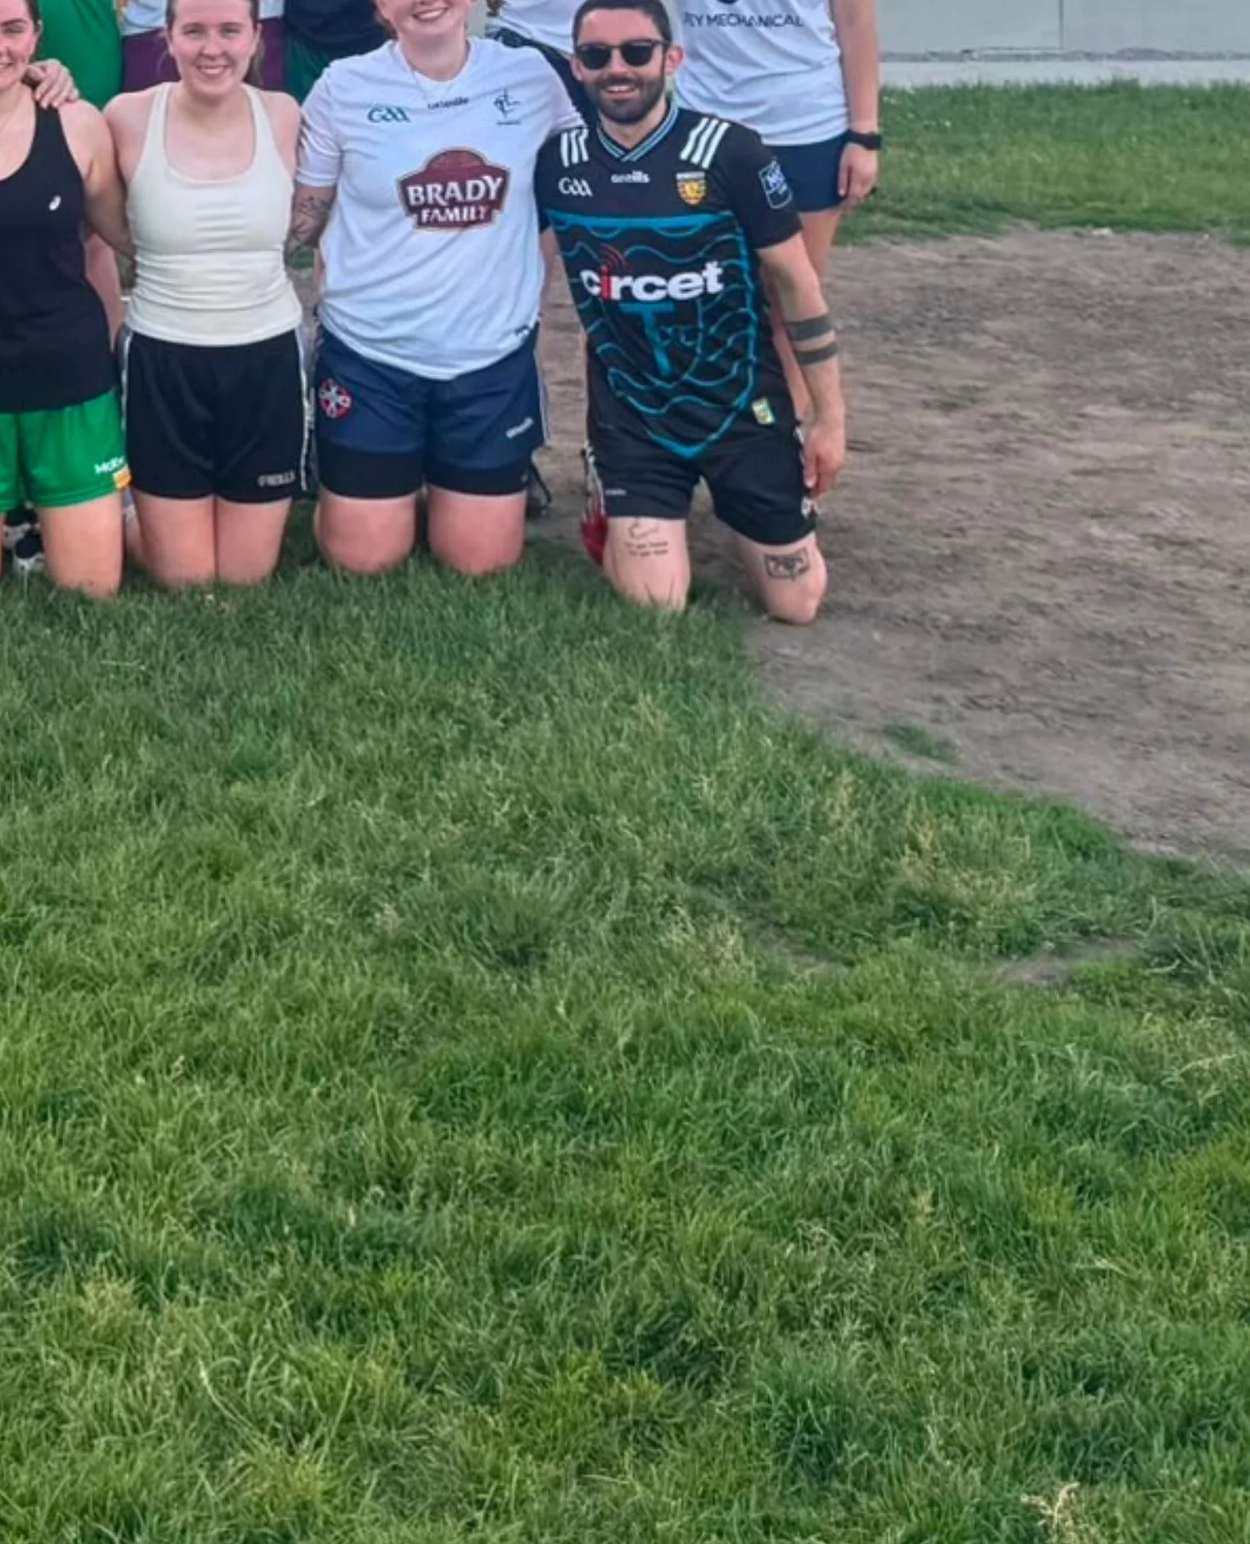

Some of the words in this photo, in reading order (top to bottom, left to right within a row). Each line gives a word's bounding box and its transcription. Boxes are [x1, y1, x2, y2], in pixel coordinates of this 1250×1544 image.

[706, 12, 804, 28] MECHANICAL
[367, 106, 412, 124] GAA
[406, 174, 504, 208] BRADY
[558, 177, 593, 197] GAA
[421, 205, 486, 224] FAMILY
[579, 260, 724, 302] circet
